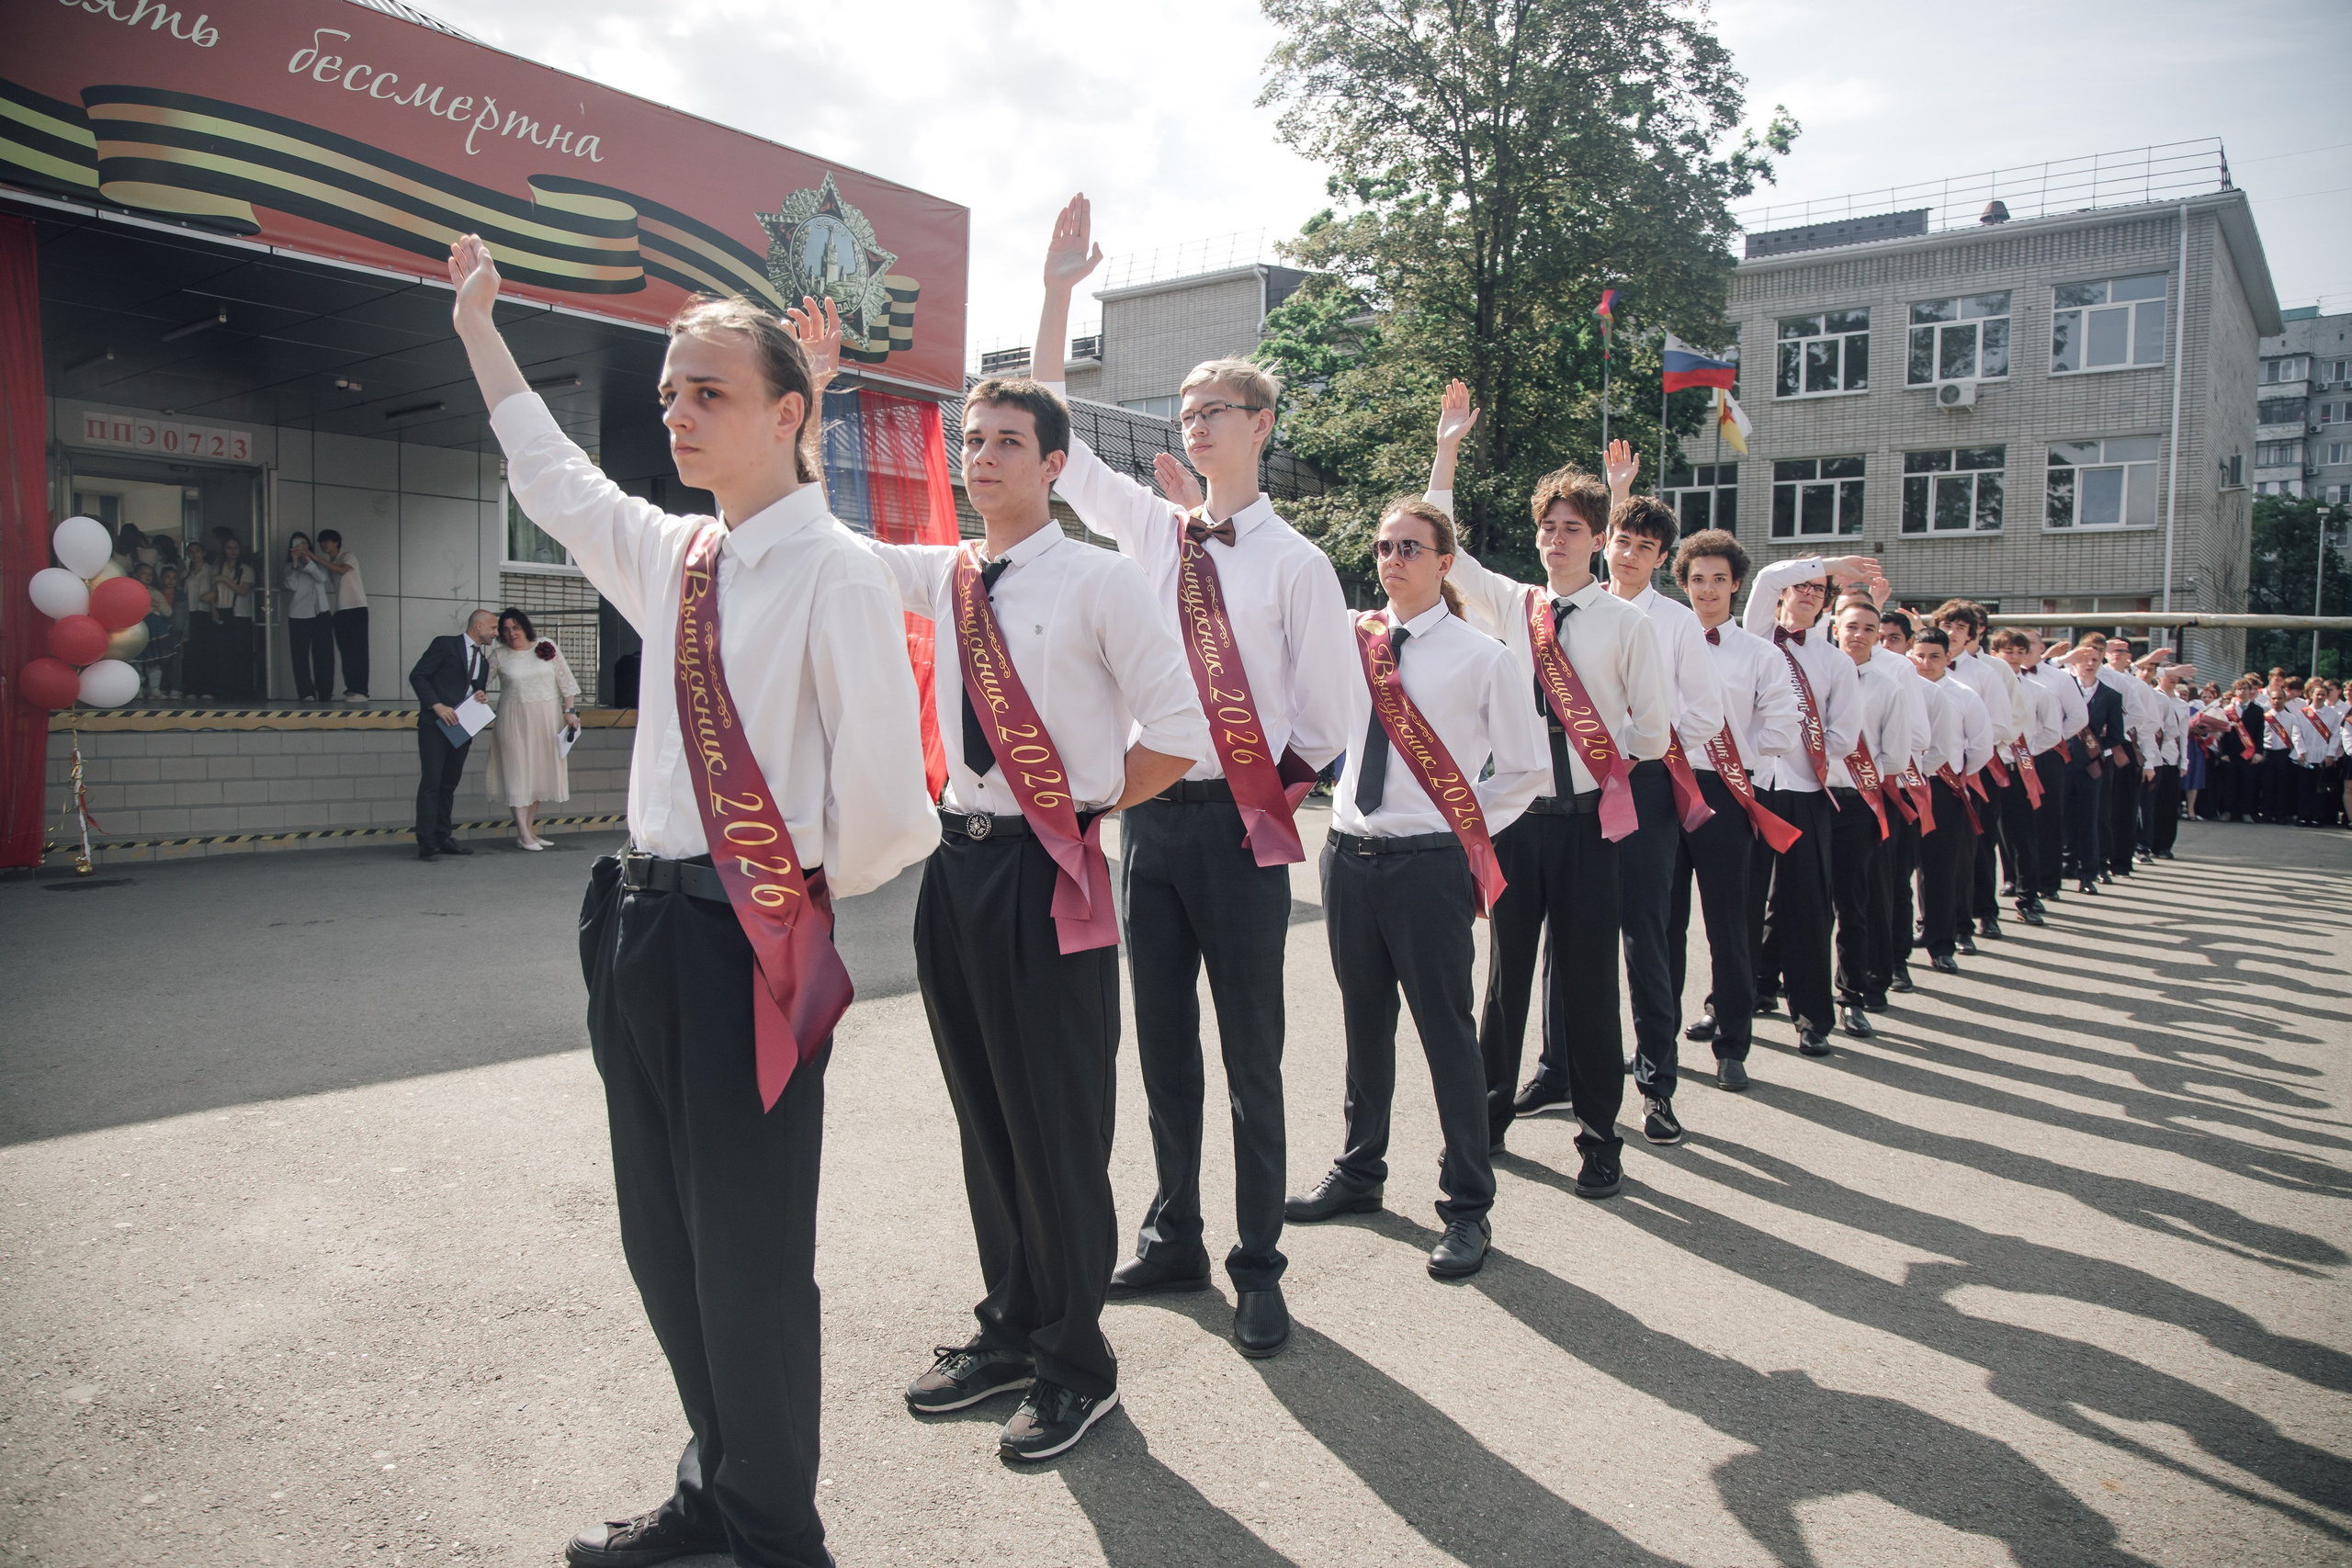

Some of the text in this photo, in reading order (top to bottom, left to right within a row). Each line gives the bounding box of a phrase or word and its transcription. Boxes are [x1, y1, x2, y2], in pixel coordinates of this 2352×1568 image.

[59, 0, 605, 163] ять бессмертна
[811, 294, 851, 313] ПОДА
[85, 419, 248, 460] ППЭ0723
[677, 547, 801, 908] Выпускник 2026
[958, 552, 1071, 808] Выпускник 2026
[1179, 538, 1266, 765] Выпускник 2026
[1371, 643, 1480, 830] Выпускник 2026
[1565, 705, 1616, 761] 2026
